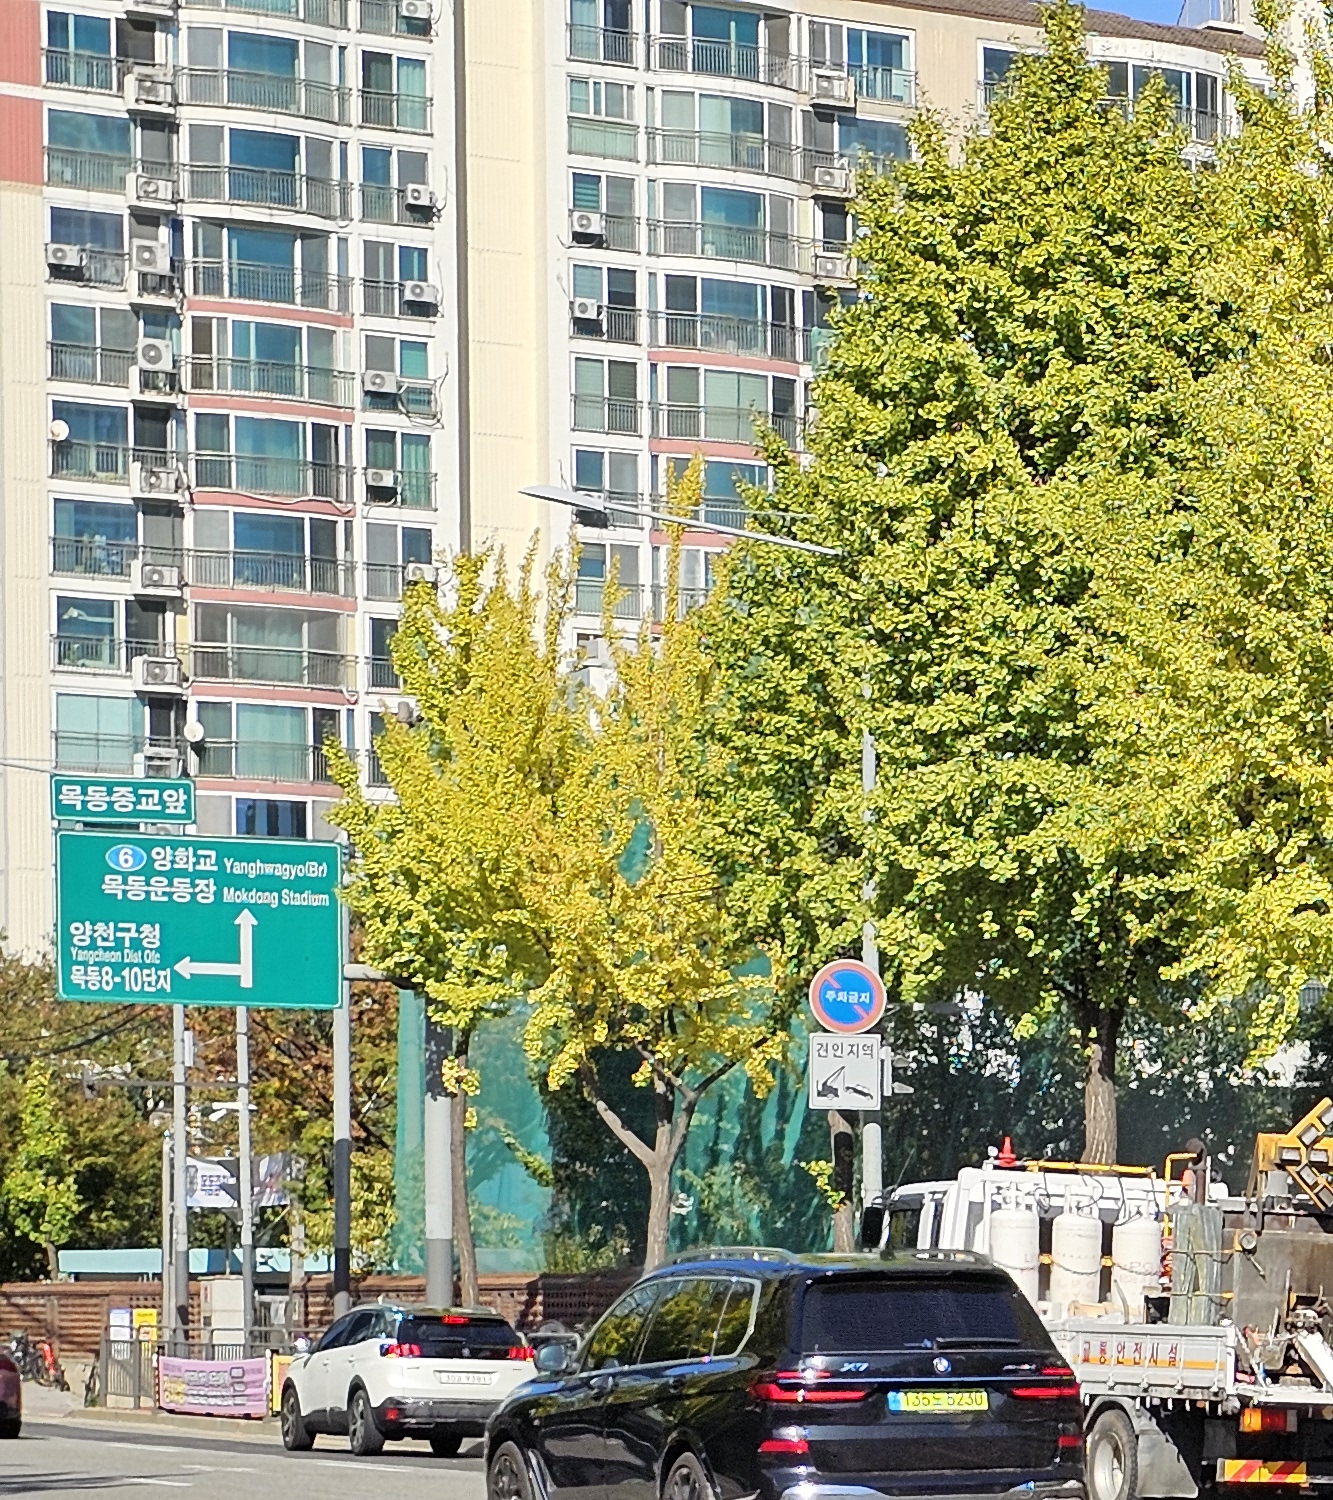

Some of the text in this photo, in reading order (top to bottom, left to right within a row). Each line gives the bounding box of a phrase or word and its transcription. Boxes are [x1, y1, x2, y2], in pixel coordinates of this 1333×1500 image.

[58, 784, 188, 815] 목동중교앞
[118, 848, 134, 869] 6
[151, 845, 218, 873] 양화교
[101, 874, 330, 909] 목동운동장 Mokdong Stadium
[69, 920, 161, 948] 양천구청
[70, 965, 172, 993] 목동8-10단지
[825, 990, 870, 1005] 주차금지
[816, 1042, 874, 1060] 견인지역
[1082, 1340, 1178, 1367] 교통안전시설
